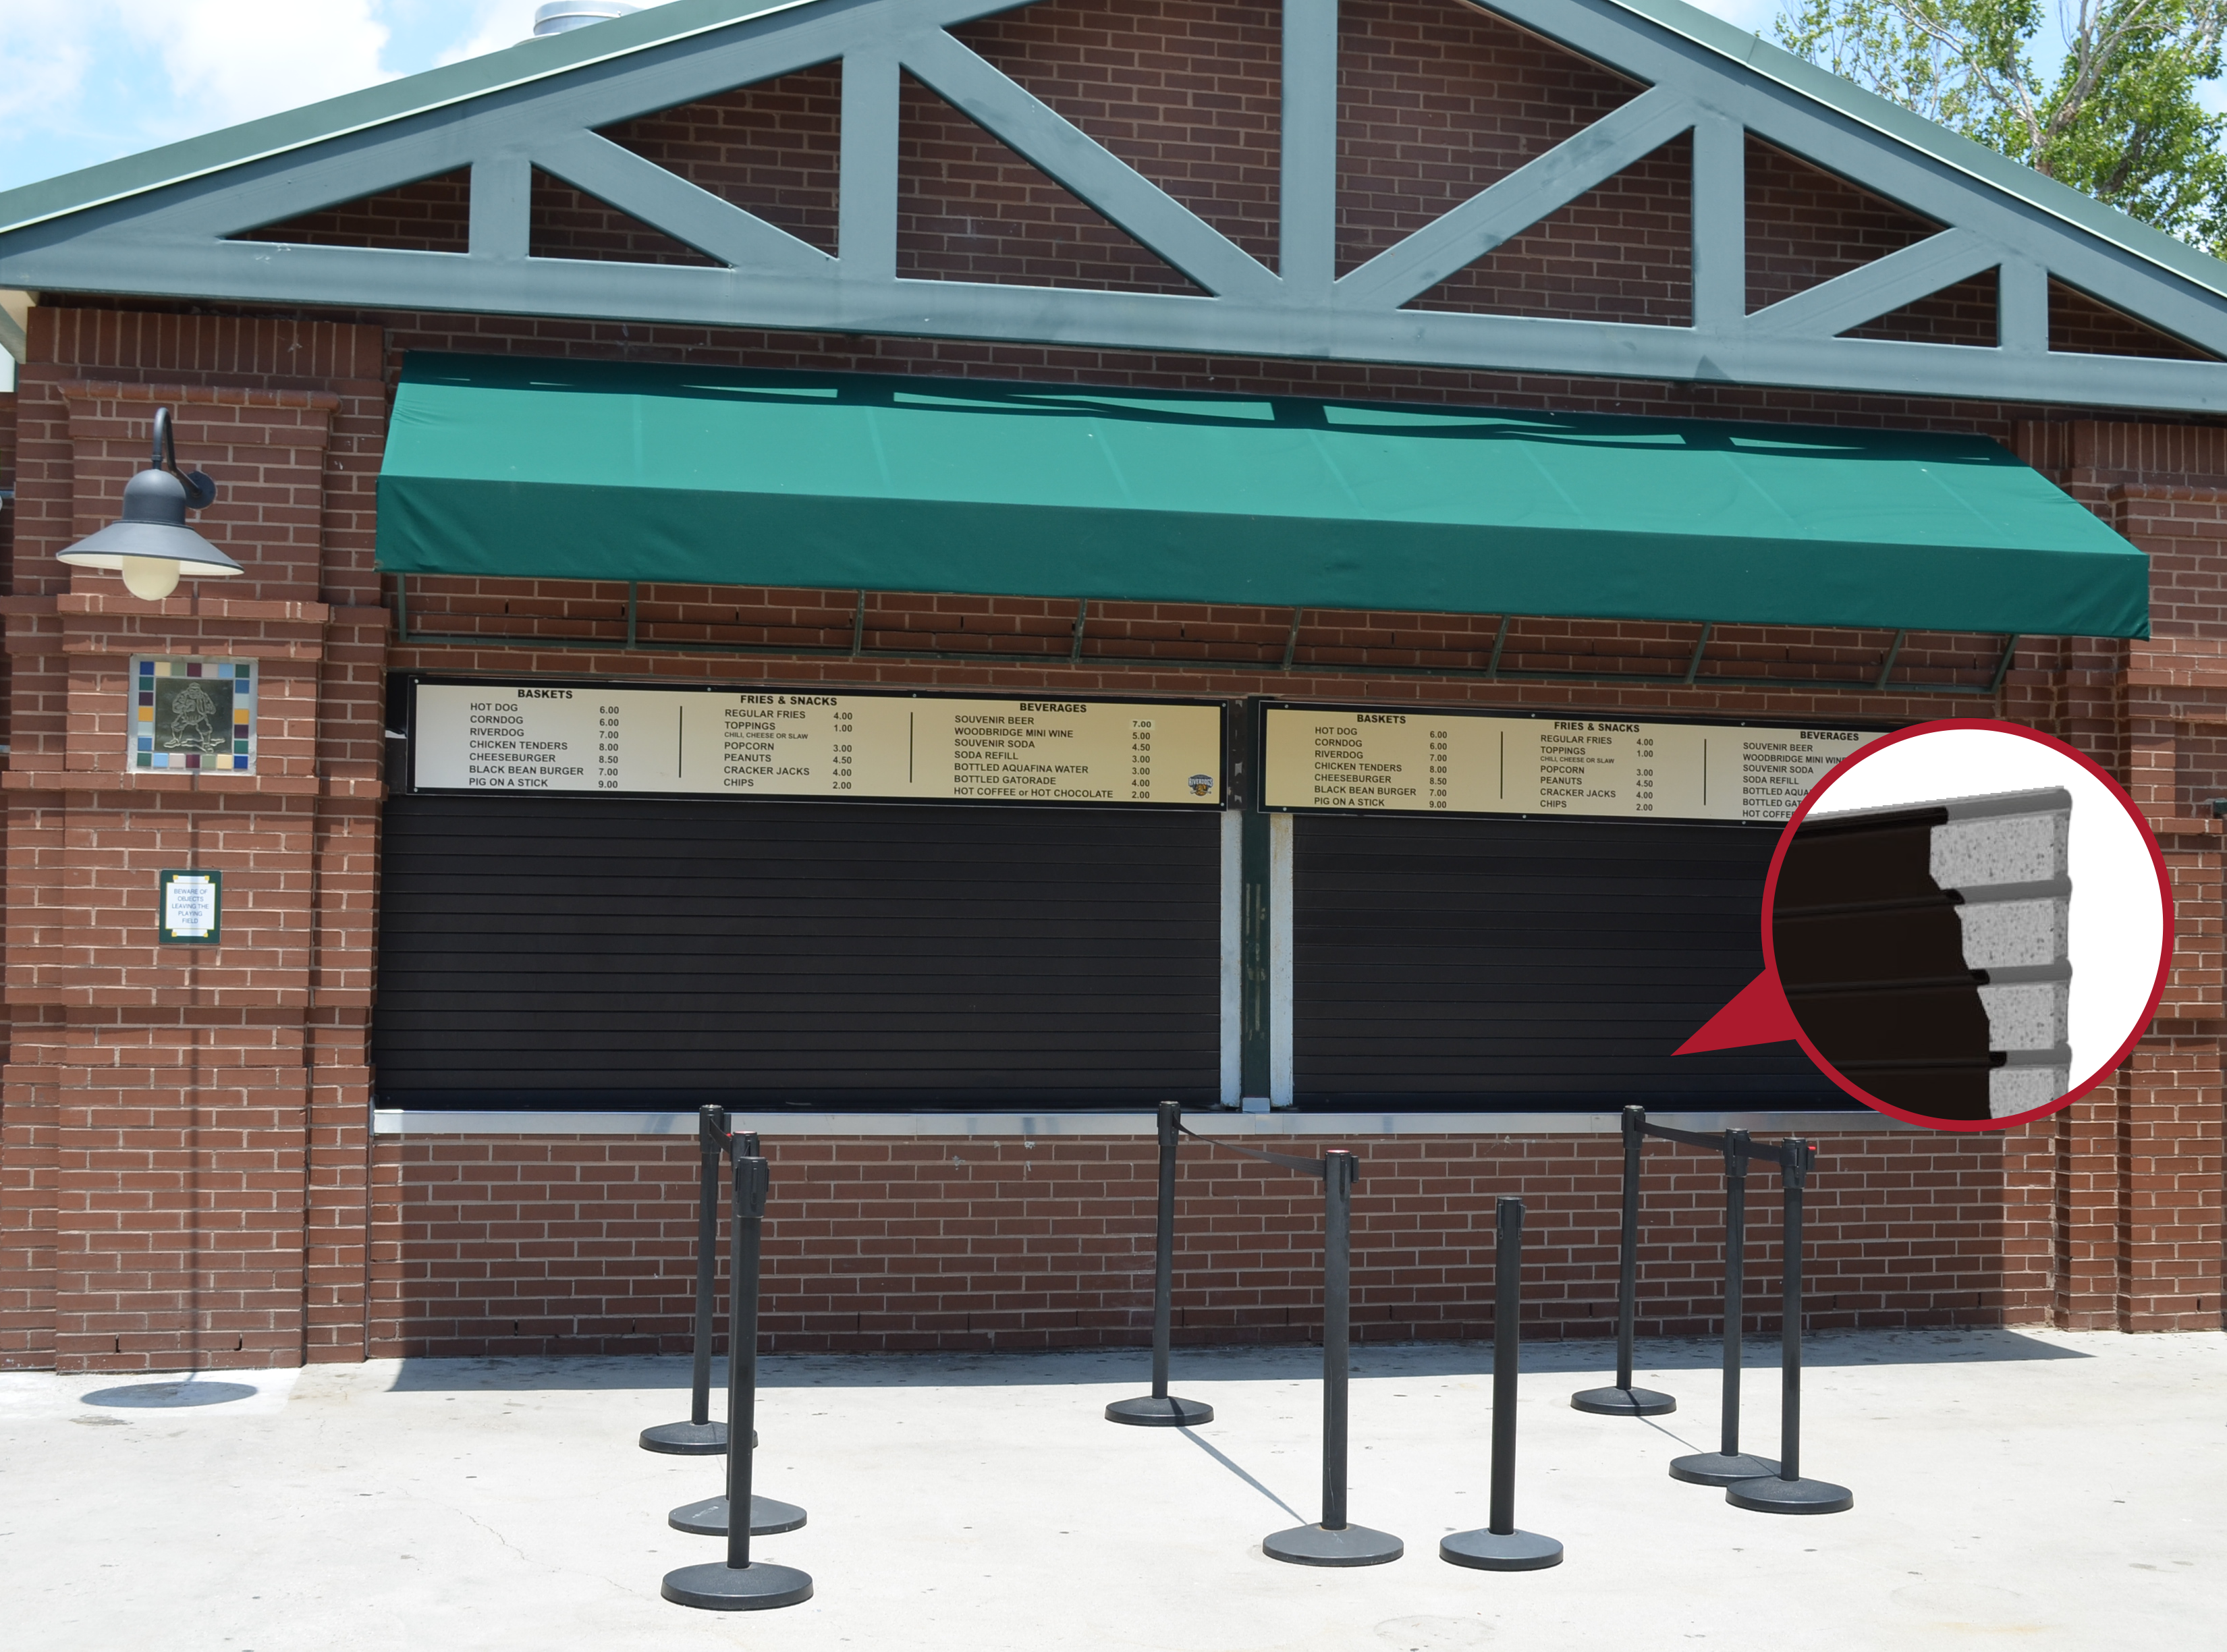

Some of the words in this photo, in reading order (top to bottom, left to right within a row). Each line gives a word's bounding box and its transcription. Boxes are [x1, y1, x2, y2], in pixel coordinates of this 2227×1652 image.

[518, 689, 573, 699] BASKETS
[740, 695, 773, 704] FRIES
[778, 696, 786, 705] &
[790, 696, 837, 706] SNACKS
[470, 703, 492, 711] HOT
[495, 703, 518, 712] DOG
[599, 706, 620, 714] 6.00
[1020, 703, 1087, 713] BEVERAGES
[725, 709, 774, 718] REGULAR
[777, 710, 806, 719] FRIES
[833, 712, 853, 720] 4.00
[955, 715, 1005, 724] SOUVENIR
[1008, 717, 1035, 725] BEER
[1357, 714, 1406, 724] BASKETS
[470, 715, 524, 724] CORNDOG
[599, 718, 619, 727] 6.00
[725, 721, 776, 730] TOPPINGS
[834, 724, 852, 732] 1.00
[1554, 721, 1584, 730] FRIES
[1587, 723, 1595, 731] &
[1598, 723, 1640, 732] SNACKS
[470, 727, 524, 737] RIVERDOG
[599, 730, 619, 739] 7.00
[954, 727, 1023, 737] WOODBRIDGE
[1026, 729, 1046, 737] MINI
[1048, 729, 1073, 738] WINE
[1337, 727, 1358, 736] DOG
[1429, 730, 1448, 738] 6.00
[1800, 731, 1859, 741] BEVERAGES
[470, 740, 516, 749] CHICKEN
[519, 741, 568, 750] TENDERS
[599, 743, 619, 751] 8.00
[954, 738, 1005, 748] SOUVENIR
[1008, 740, 1035, 748] SODA
[1132, 743, 1151, 751] 4.50
[1315, 738, 1363, 747] CORNDOG
[1429, 742, 1448, 750] 6.00
[1541, 734, 1584, 744] REGULAR
[1587, 736, 1612, 744] FRIES
[1637, 738, 1653, 746] 4.00
[724, 742, 774, 750] POPCORN
[833, 744, 852, 752] 3.00
[1541, 746, 1586, 755] TOPPINGS
[1743, 742, 1788, 751] SOUVENIR
[1790, 744, 1813, 752] BEER
[469, 752, 555, 763] CHEESEBURGER
[599, 755, 619, 764] 8.50
[724, 753, 771, 762] PEANUTS
[833, 756, 852, 764] 4.50
[954, 750, 983, 759] SODA
[985, 751, 1018, 760] REFILL
[1132, 755, 1151, 763] 3.00
[1315, 750, 1363, 759] RIVERDOG
[1429, 754, 1447, 762] 7.00
[1742, 754, 1803, 763] WOODBRIDGE
[469, 765, 505, 773] BLACK
[508, 766, 537, 774] BEAN
[540, 767, 584, 775] BURGER
[599, 768, 618, 776] 7.00
[723, 766, 773, 775] CRACKER
[776, 767, 810, 775] JACKS
[833, 769, 852, 777] 4.00
[954, 763, 999, 771] BOTTLED
[1002, 764, 1053, 773] AQUAFINA
[1055, 765, 1089, 773] WATER
[1132, 767, 1150, 775] 3.00
[1315, 762, 1356, 771] CHICKEN
[1358, 763, 1402, 772] TENDERS
[1429, 765, 1447, 773] 8.00
[1541, 765, 1585, 774] POPCORN
[1637, 769, 1653, 777] 3.00
[1743, 764, 1787, 773] SOUVENIR
[1790, 766, 1814, 774] SODA
[489, 778, 504, 786] ON
[518, 779, 548, 787] STICK
[599, 780, 618, 788] 9.00
[723, 778, 754, 787] CHIPS
[833, 781, 852, 790] 2.00
[954, 775, 999, 783] BOTTLED
[1002, 776, 1056, 785] GATORADE
[1132, 779, 1150, 787] 4.00
[1188, 778, 1213, 787] RIVERDOGS
[1315, 773, 1392, 783] CHEESEBURGER
[1429, 777, 1447, 786] 8.50
[1541, 776, 1583, 785] PEANUTS
[1636, 779, 1653, 788] 4.50
[1742, 775, 1767, 783] SODA
[1769, 776, 1799, 785] REFILL
[954, 787, 974, 795] HOT
[977, 788, 1016, 796] COFFEE
[1054, 789, 1113, 798] CHOCOLATE
[1315, 786, 1346, 794] BLACK
[1349, 786, 1375, 794] BEAN
[1377, 787, 1417, 796] BURGER
[1429, 789, 1447, 797] 7.00
[1540, 788, 1584, 797] CRACKER
[1587, 790, 1616, 798] JACKS
[1743, 787, 1783, 796] BOTTLED
[1784, 788, 1811, 796] AQUA
[1315, 797, 1329, 805] PIG
[1358, 798, 1385, 806] STICK
[1429, 800, 1447, 808] 9.00
[1540, 800, 1567, 808] CHIPS
[1636, 803, 1653, 811] 2.00
[1742, 798, 1783, 807] BOTTLED
